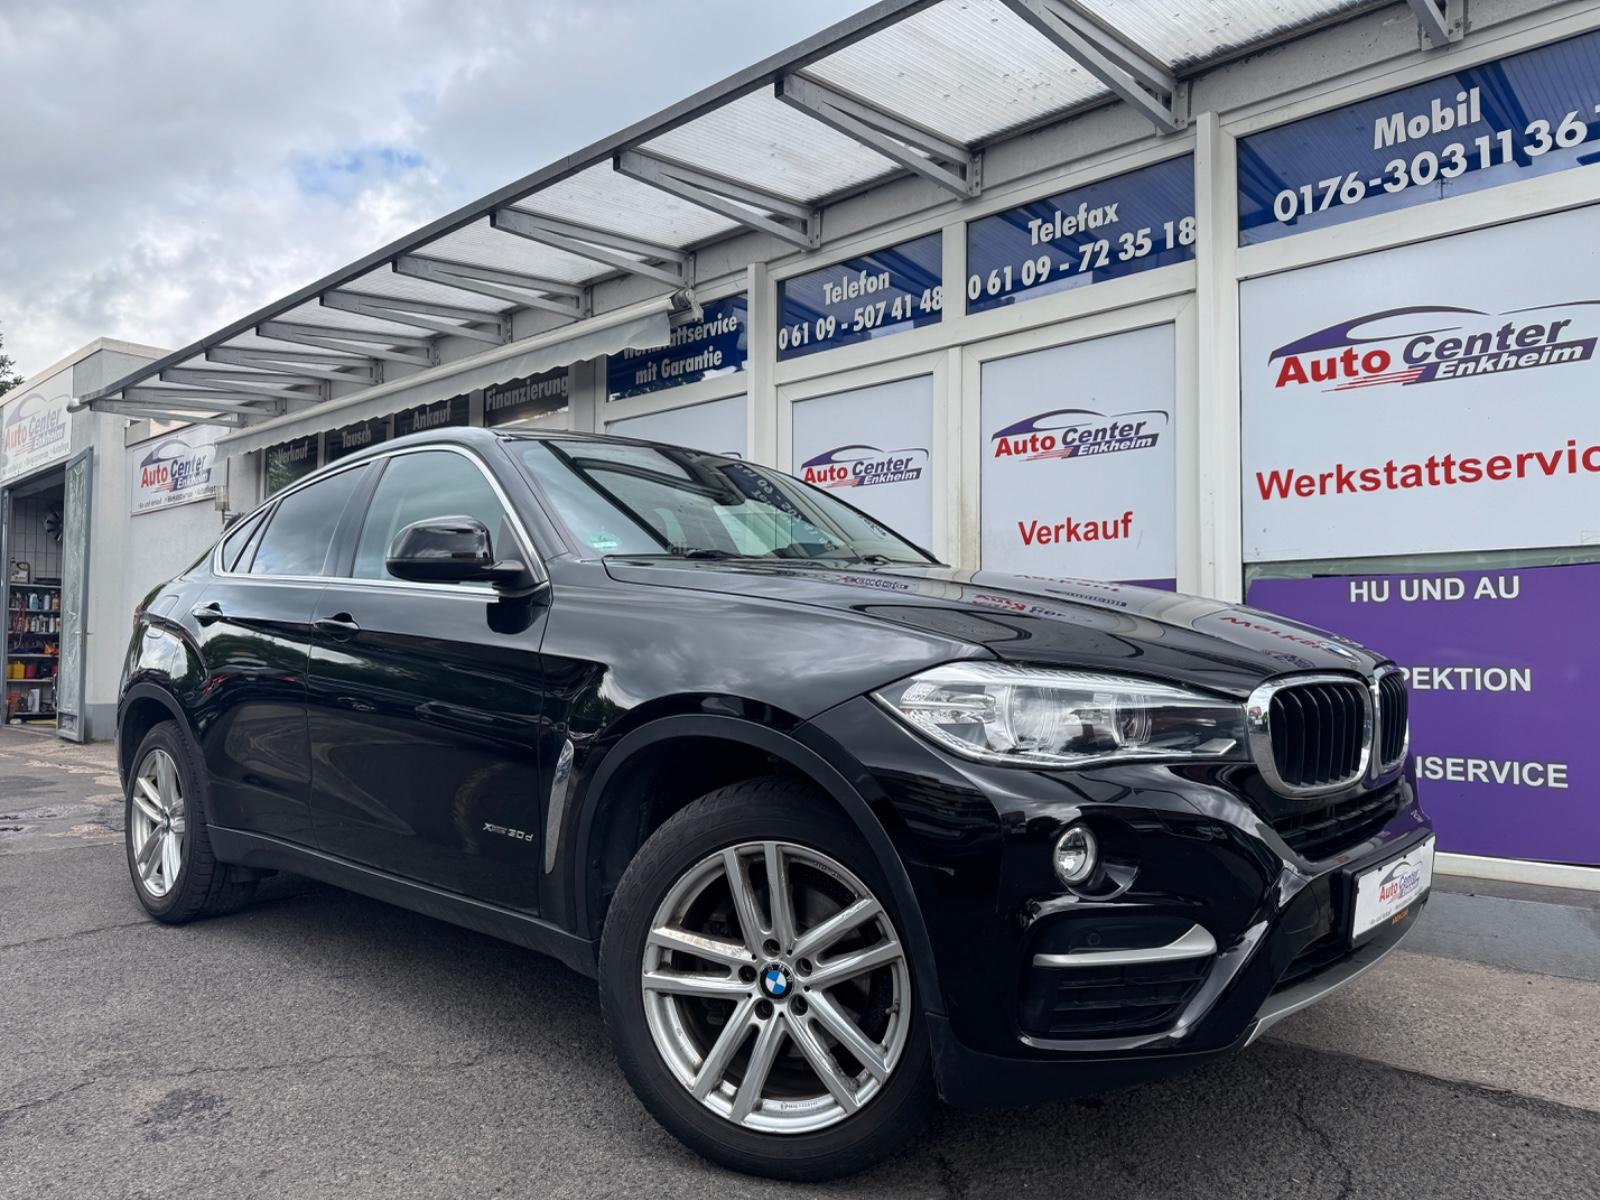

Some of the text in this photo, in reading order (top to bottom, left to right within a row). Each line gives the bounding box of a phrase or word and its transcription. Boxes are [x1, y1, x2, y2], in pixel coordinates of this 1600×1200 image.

[1374, 87, 1481, 150] Mobil
[1028, 202, 1119, 246] Telefax
[967, 274, 981, 300] 0
[986, 265, 1013, 296] 61
[1021, 255, 1051, 286] 09
[1078, 239, 1110, 272] 72
[1118, 227, 1152, 262] 35
[1164, 216, 1196, 249] 18
[822, 270, 890, 305] Telefon
[791, 322, 809, 347] 61
[815, 315, 836, 341] 09
[853, 300, 887, 332] 507
[891, 293, 912, 321] 41
[919, 285, 943, 313] 48
[623, 313, 738, 359] attservice
[1275, 319, 1572, 388] Auto Center
[635, 345, 722, 385] mit Garantie
[1433, 344, 1584, 380] Enkheim
[485, 375, 569, 412] Finanzierung
[412, 402, 451, 430] Ankauf
[4, 424, 27, 452] Auto
[278, 440, 309, 464] Verkauf
[341, 424, 372, 449] Tausch
[994, 421, 1147, 458] Auto Center
[1077, 437, 1153, 457] Enkheim
[141, 464, 168, 488] Auto
[170, 455, 207, 478] Center
[804, 457, 914, 483] Auto Center
[863, 470, 917, 485] Enkheim
[1018, 511, 1133, 546] Verkauf
[1350, 575, 1520, 603] HU UND AU
